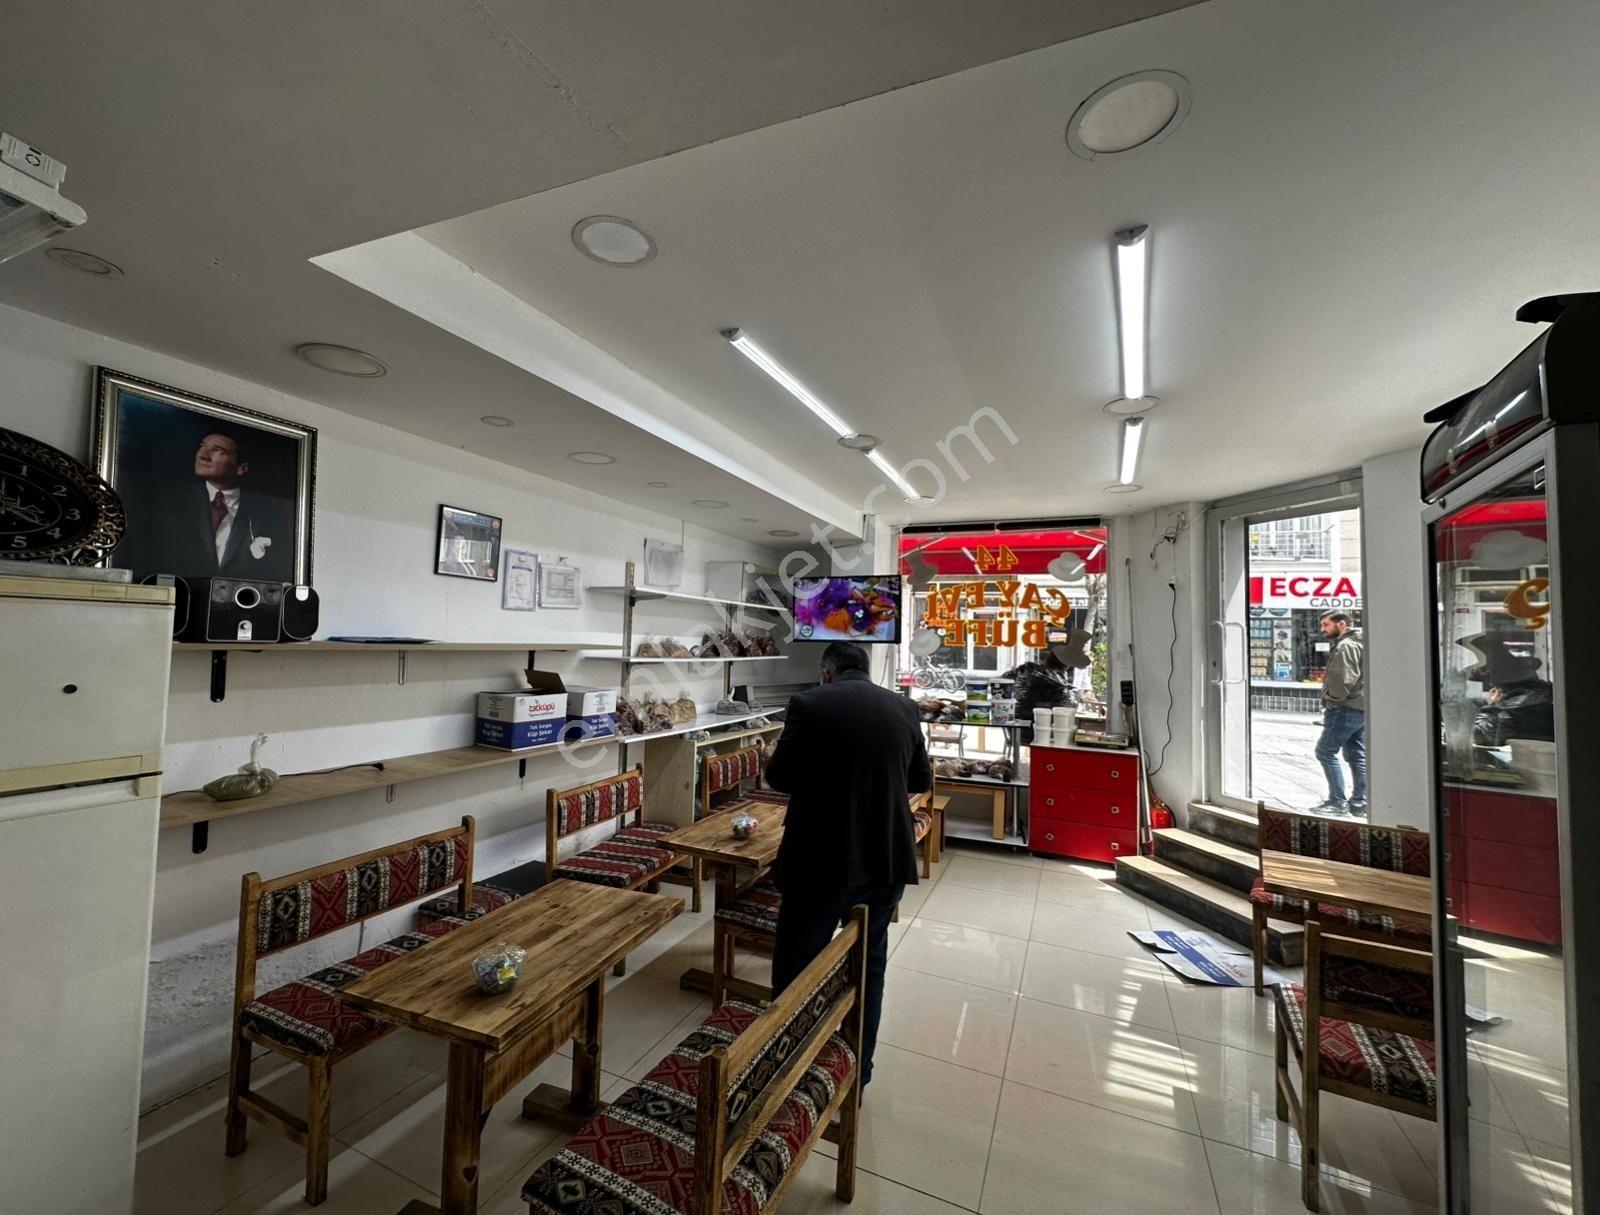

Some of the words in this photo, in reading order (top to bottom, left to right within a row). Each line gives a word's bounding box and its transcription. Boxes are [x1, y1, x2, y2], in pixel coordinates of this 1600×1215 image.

[19, 465, 28, 476] 1
[52, 484, 67, 496] 2
[66, 508, 81, 520] 3
[47, 527, 61, 539] 4
[11, 536, 27, 548] 5
